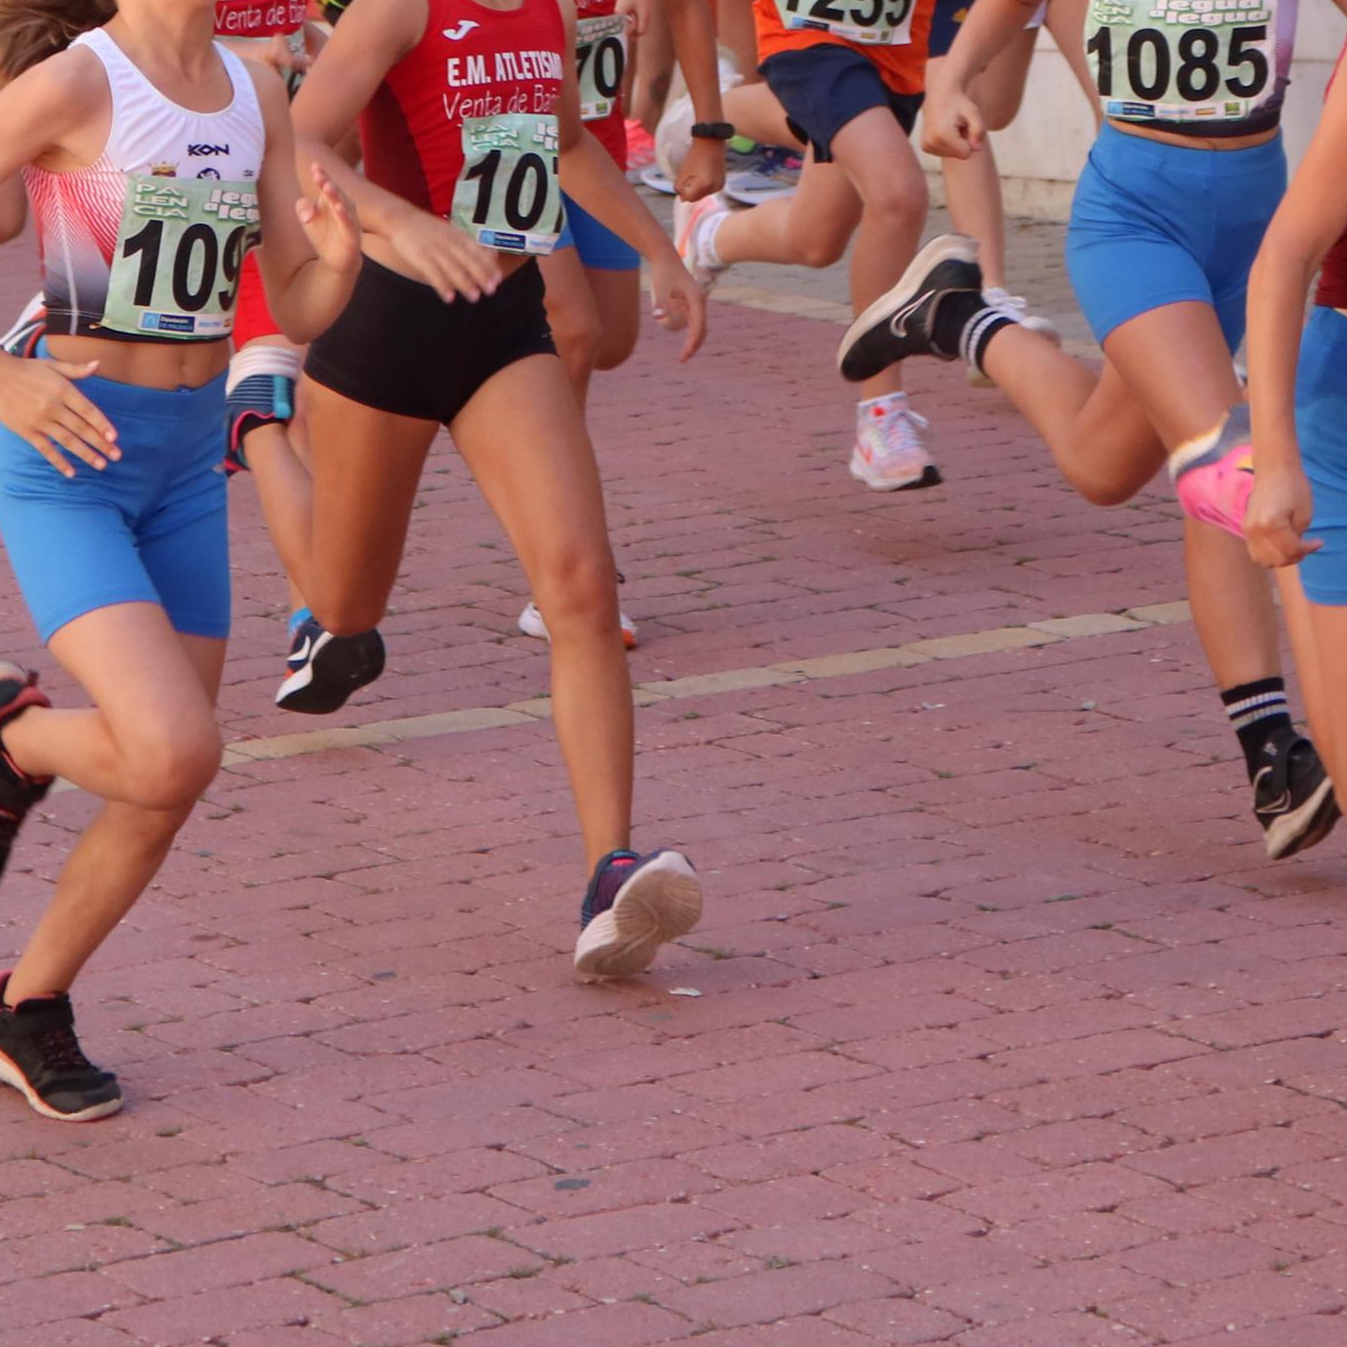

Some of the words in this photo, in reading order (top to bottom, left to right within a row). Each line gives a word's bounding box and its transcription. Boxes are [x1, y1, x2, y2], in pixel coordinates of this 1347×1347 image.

[447, 54, 492, 87] E.M.
[1087, 25, 1269, 101] 1085
[442, 90, 502, 120] Venta
[507, 85, 529, 115] de
[134, 193, 189, 208] LEN
[135, 183, 179, 196] PA
[462, 149, 566, 235] 10
[133, 204, 189, 219] CIA
